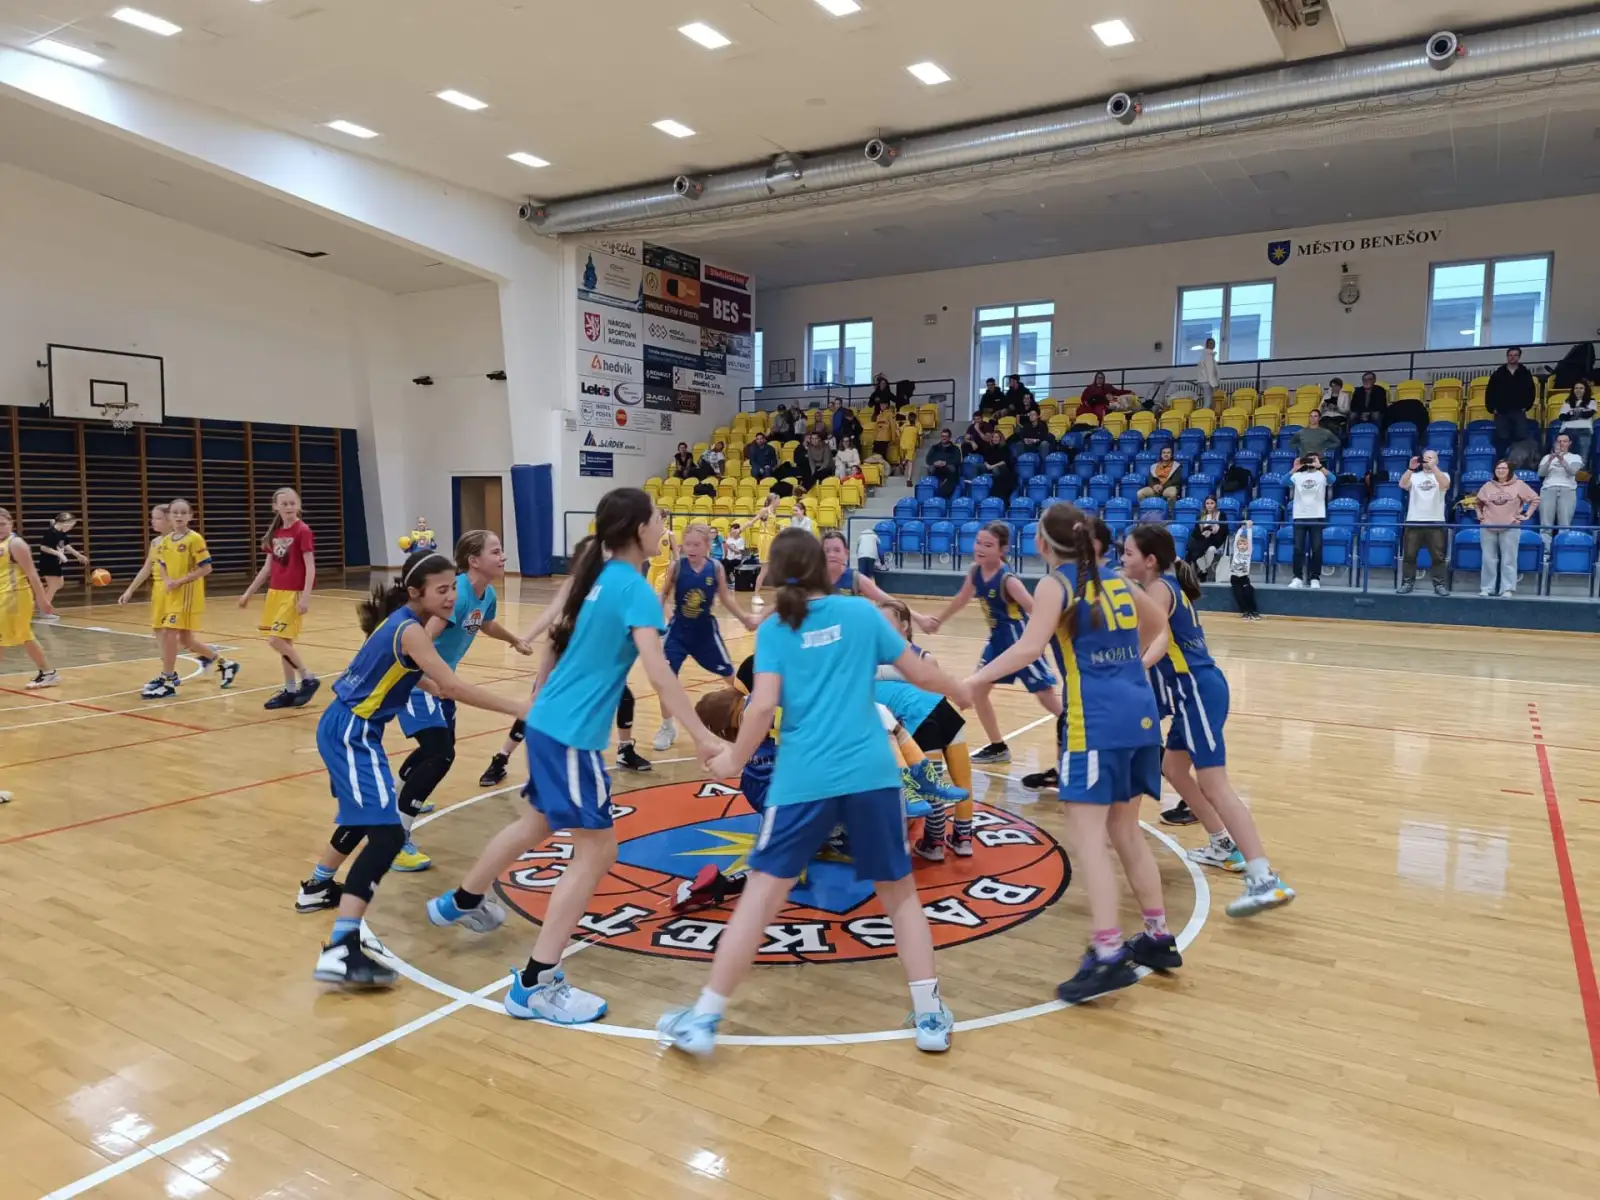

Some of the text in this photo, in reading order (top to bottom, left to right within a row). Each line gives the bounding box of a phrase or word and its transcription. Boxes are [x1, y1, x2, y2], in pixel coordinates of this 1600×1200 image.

[1297, 229, 1442, 257] MĚSTO BENEŠOV
[713, 297, 739, 324] BES
[607, 317, 632, 329] NÁRODNÍ
[607, 327, 637, 340] SPORTOVNÍ
[607, 337, 636, 349] AGENTURA
[602, 359, 633, 375] hedvik
[581, 381, 610, 397] Lekis
[645, 393, 672, 402] DACIA
[1086, 578, 1138, 632] 15
[272, 621, 287, 633] 27
